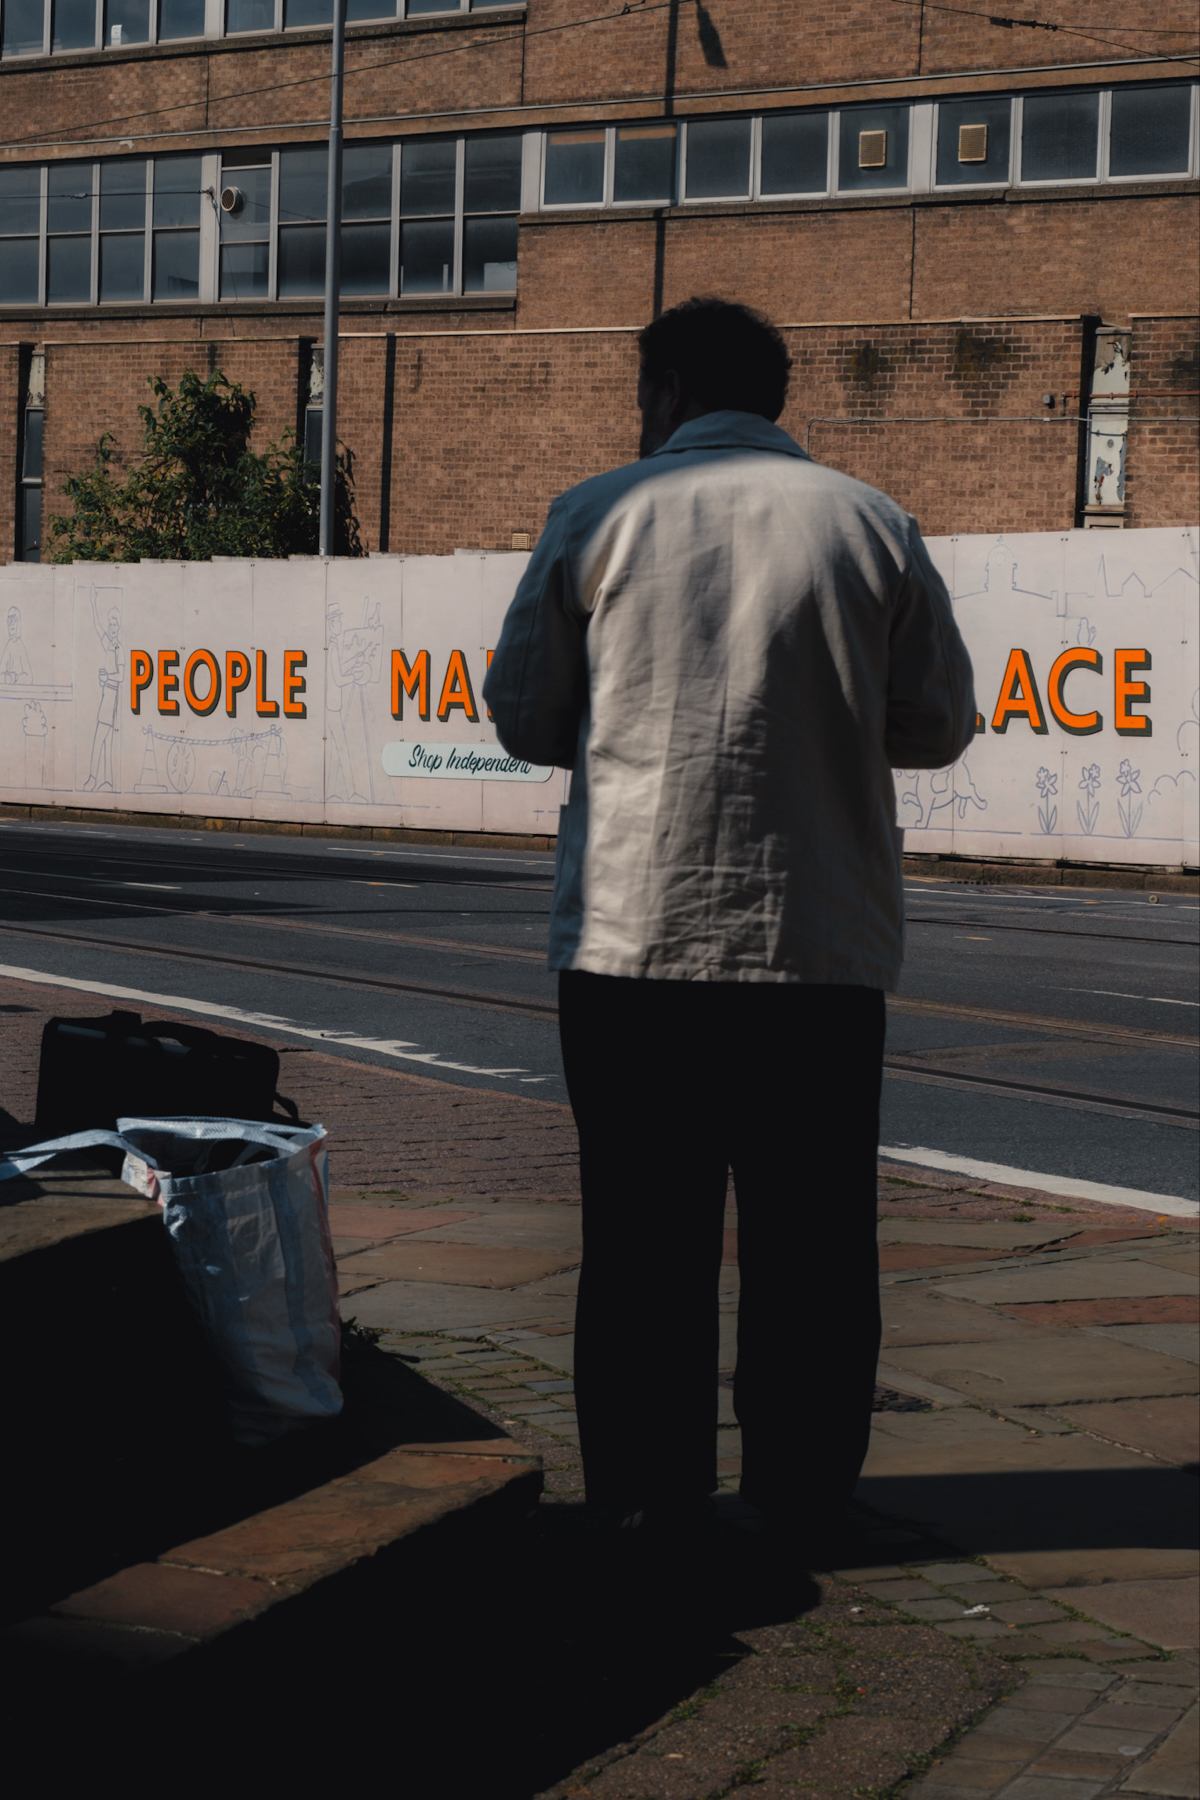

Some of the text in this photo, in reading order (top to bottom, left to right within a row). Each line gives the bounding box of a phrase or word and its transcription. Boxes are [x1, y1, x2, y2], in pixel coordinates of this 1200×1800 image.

[130, 646, 1152, 737] PEOPLE MA ACE
[408, 744, 443, 773] Shop
